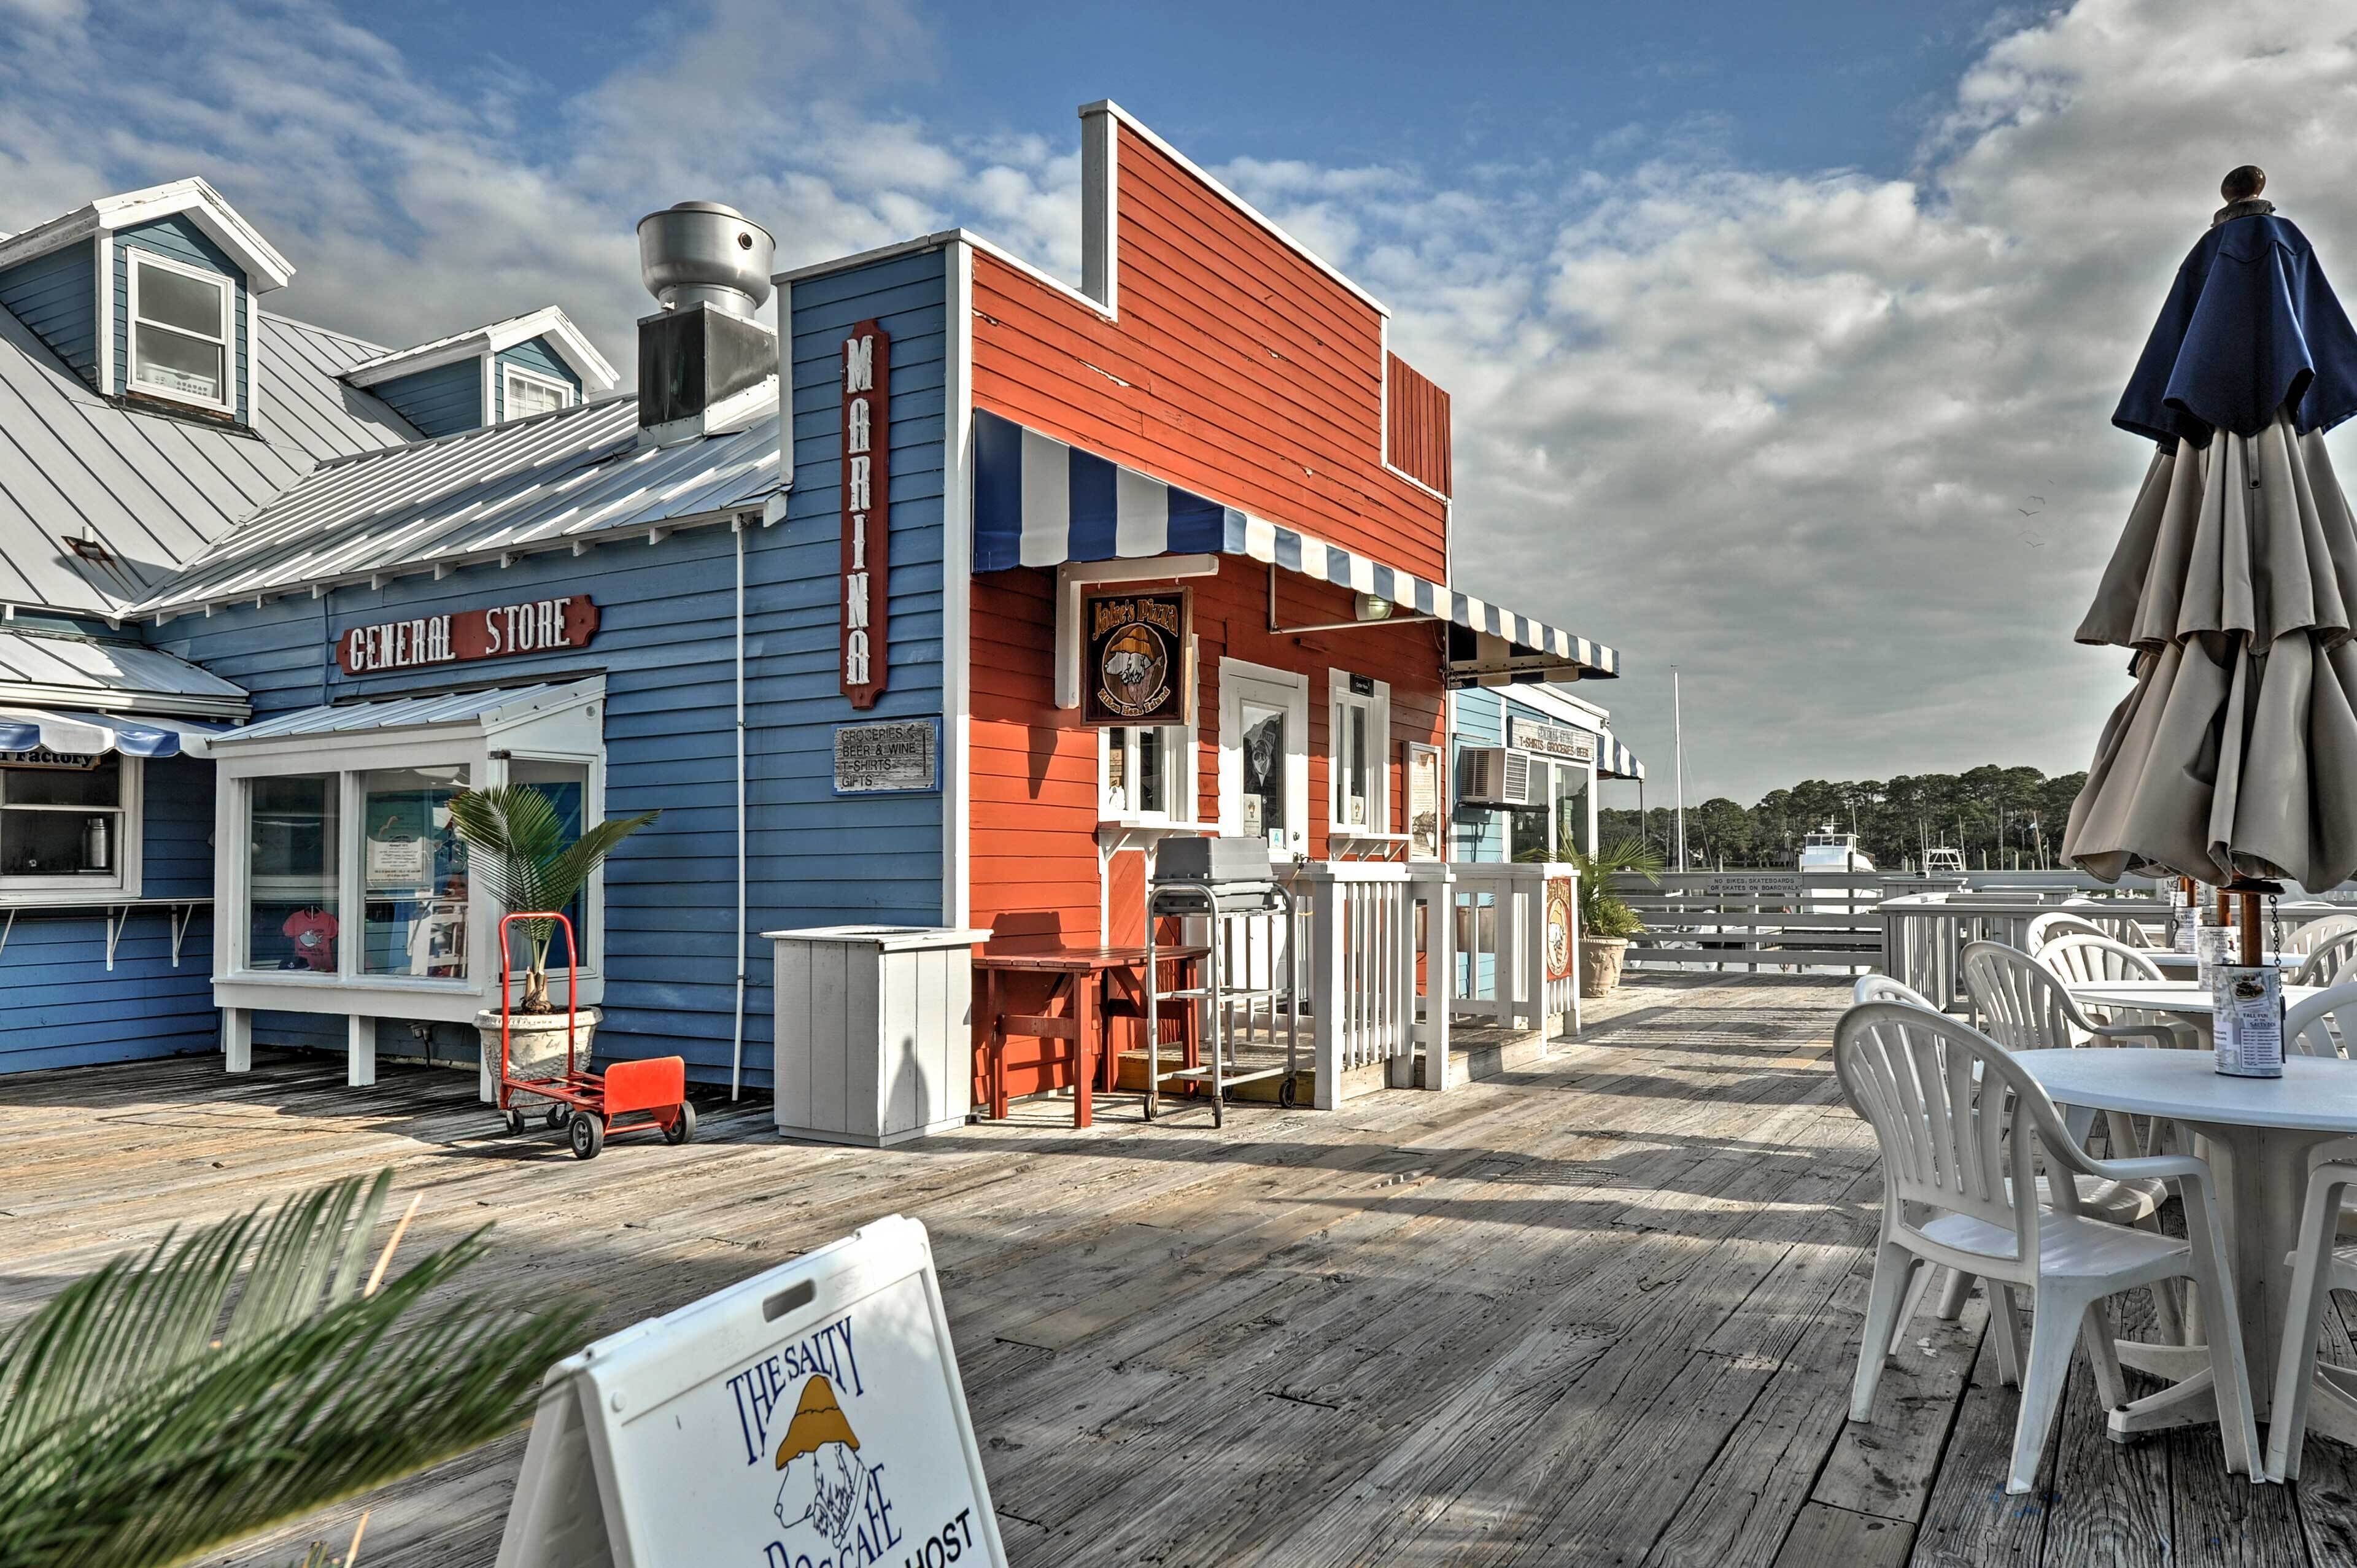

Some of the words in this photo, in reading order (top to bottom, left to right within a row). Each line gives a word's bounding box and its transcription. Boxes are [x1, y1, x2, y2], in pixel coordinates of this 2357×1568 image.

[846, 334, 875, 686] MARINA
[1093, 599, 1135, 641] Jake's
[1137, 598, 1178, 638] Pizza
[349, 614, 456, 671] GENERAL
[486, 598, 572, 655] STORE
[841, 727, 903, 743] GROCERIES
[843, 744, 870, 757] BEER
[875, 744, 883, 755] &
[889, 742, 916, 754] WINE
[1519, 736, 1544, 751] T-SHIRTS
[1546, 741, 1574, 756] GROCERIES
[1576, 747, 1589, 758] BEER
[842, 759, 891, 772] T-SHIRTS
[842, 774, 872, 787] GIFTS
[726, 1354, 786, 1467] THE
[784, 1315, 864, 1397] SALTY
